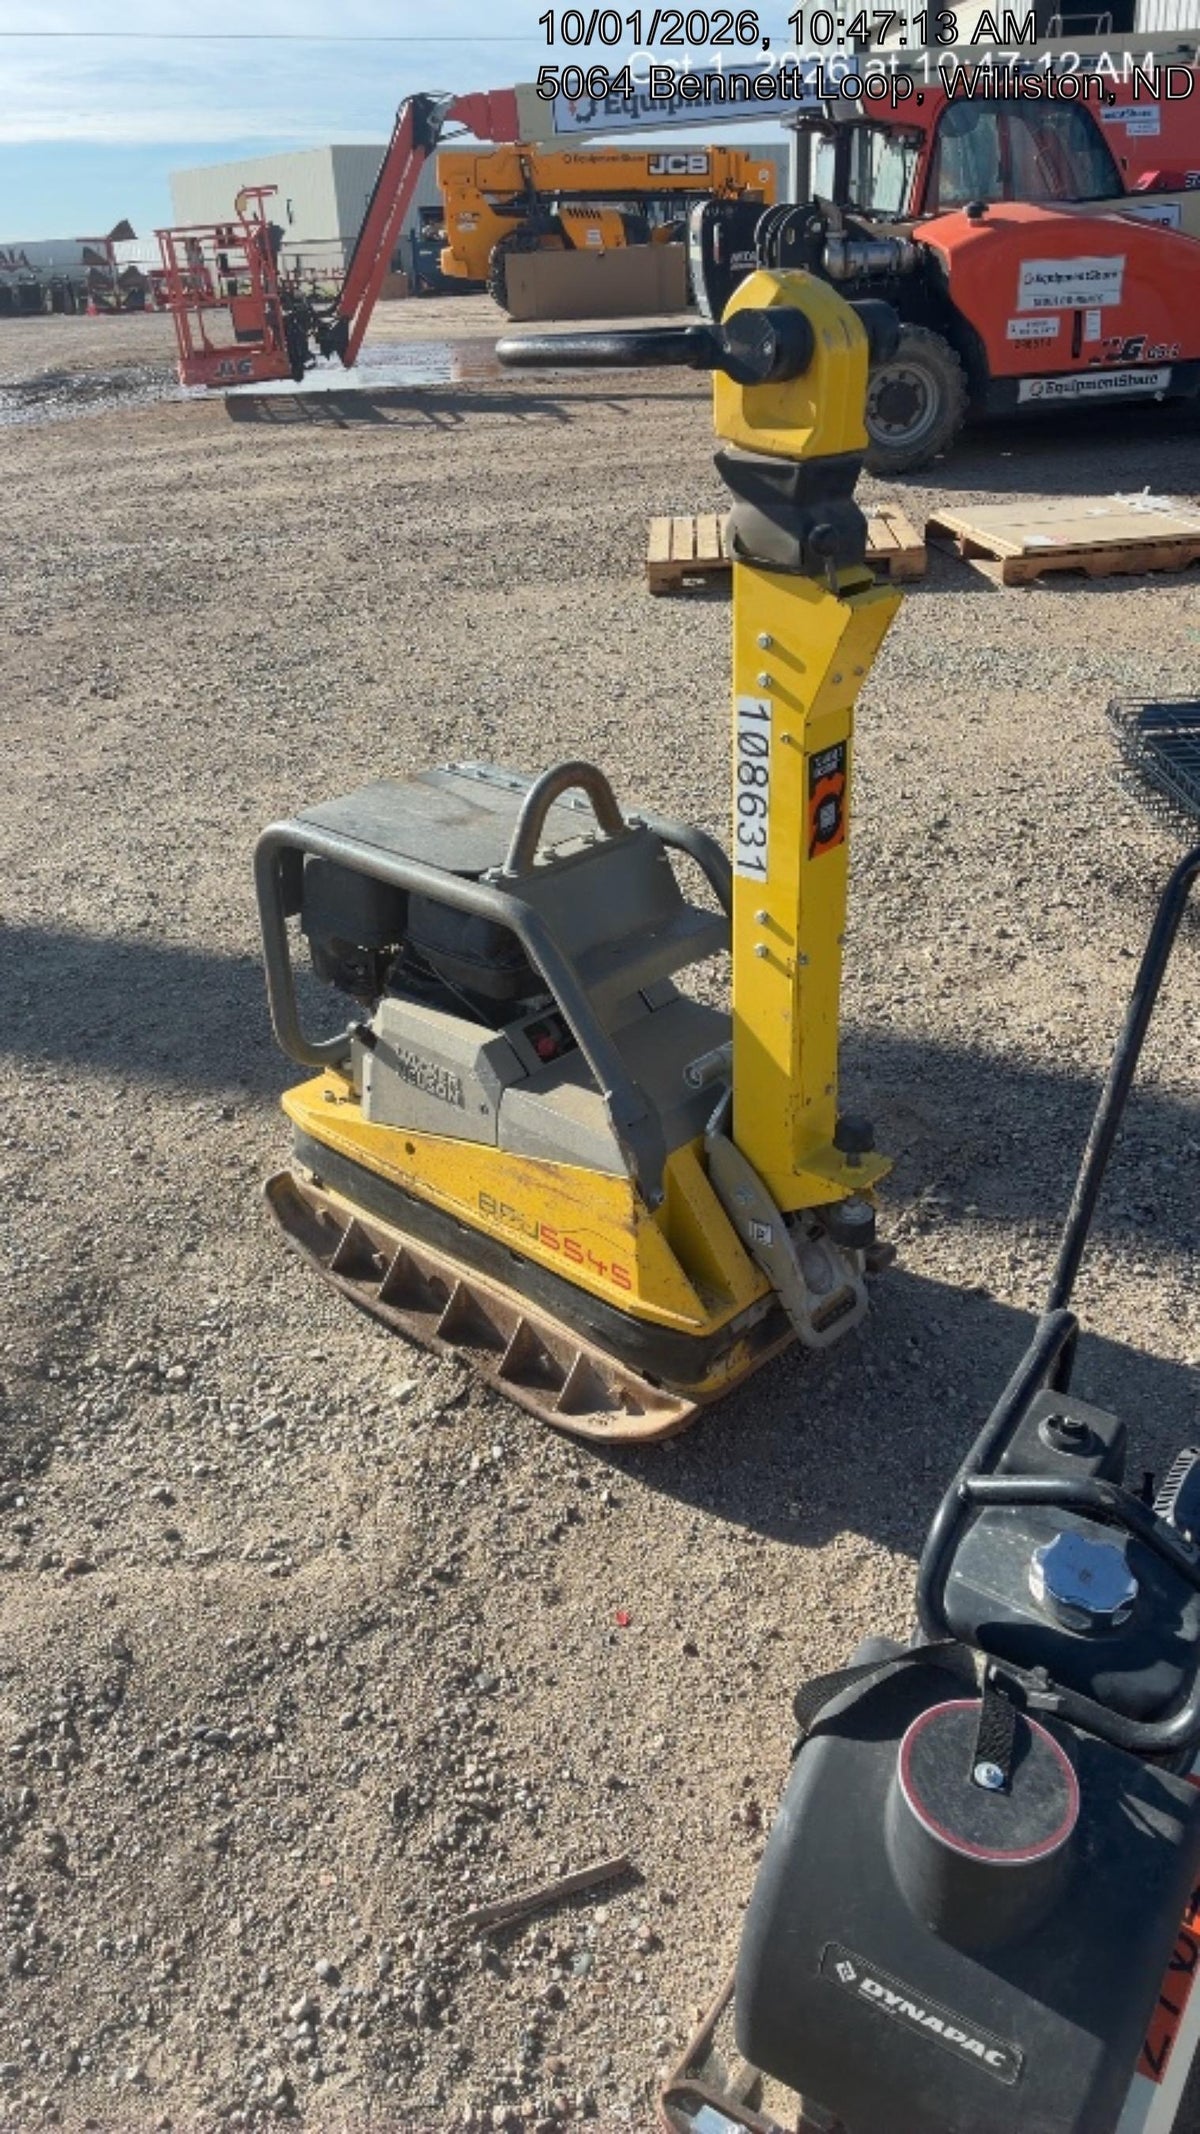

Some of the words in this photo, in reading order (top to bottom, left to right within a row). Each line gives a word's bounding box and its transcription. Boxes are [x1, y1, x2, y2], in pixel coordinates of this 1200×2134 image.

[650, 154, 709, 175] JCB
[736, 703, 771, 872] 108631
[857, 1977, 1006, 2066] DYNAPAC
